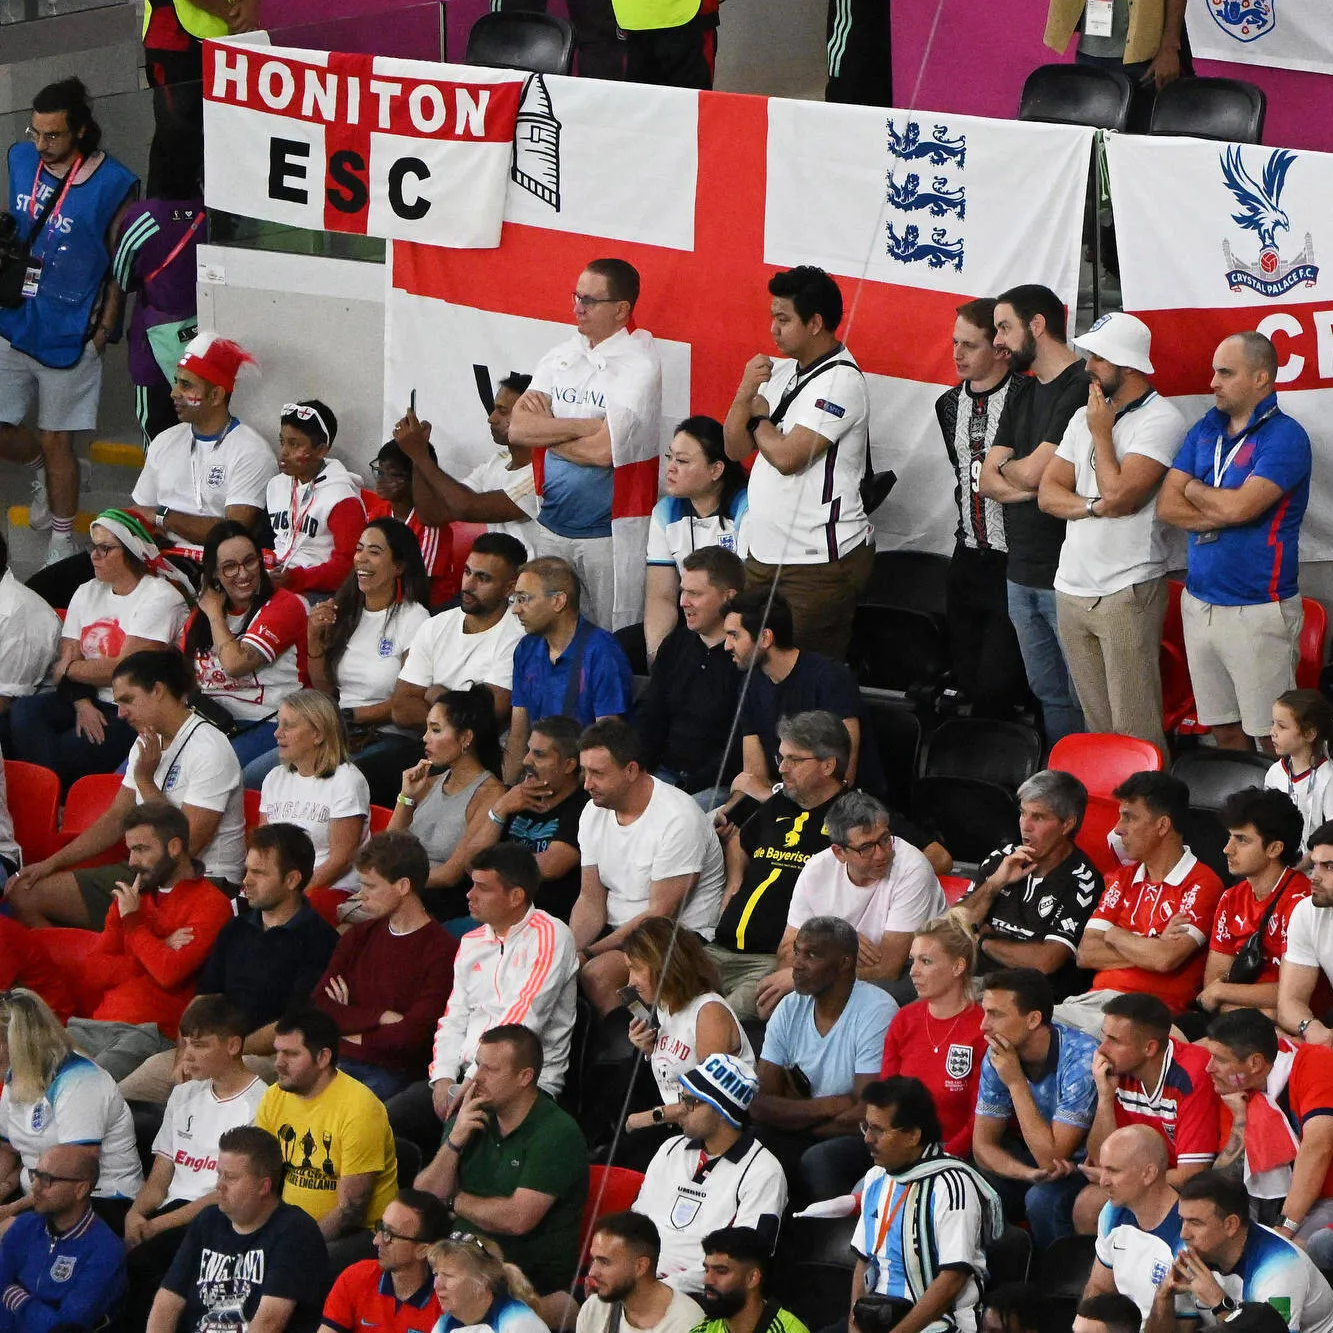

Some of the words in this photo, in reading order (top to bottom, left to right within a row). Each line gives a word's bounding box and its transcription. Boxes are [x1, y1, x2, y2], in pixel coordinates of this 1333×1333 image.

[212, 50, 491, 137] HONITON
[1231, 273, 1267, 294] CRYSTAL
[1266, 272, 1299, 295] PALACE
[1299, 268, 1314, 279] F.C.
[766, 846, 814, 865] Bayerisc
[174, 1149, 218, 1173] Engla
